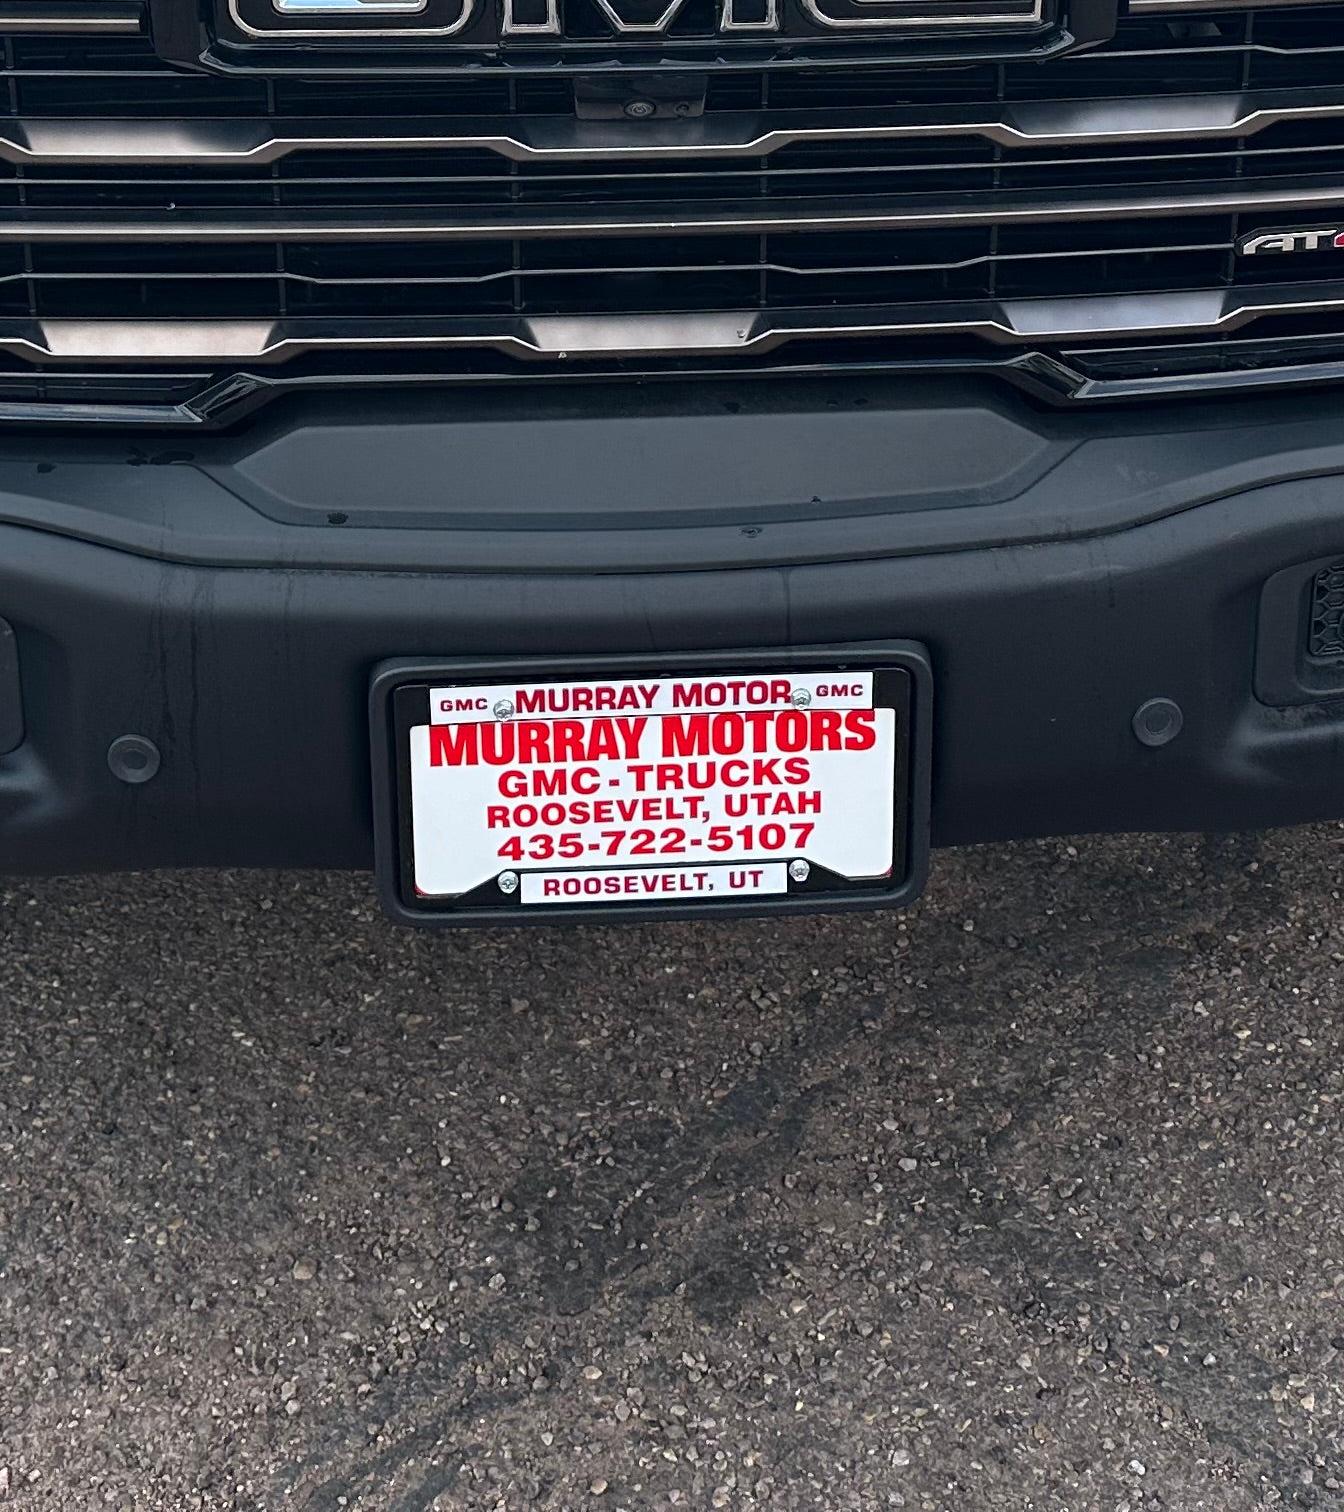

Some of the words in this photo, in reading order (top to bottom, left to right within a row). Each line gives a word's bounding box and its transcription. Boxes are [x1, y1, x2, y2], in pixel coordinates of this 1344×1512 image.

[440, 698, 488, 712] GMC
[515, 683, 660, 714] MURRAY
[672, 679, 791, 708] MOTOR
[815, 684, 864, 697] GMC
[429, 716, 648, 767] MURRAY
[661, 709, 876, 758] MOTORS
[487, 795, 710, 829] ROOSEVELT,
[724, 790, 822, 818] UTAH
[497, 821, 815, 861] 435-722-5107
[543, 872, 714, 897] ROOSEVELT,
[728, 869, 764, 889] UT
